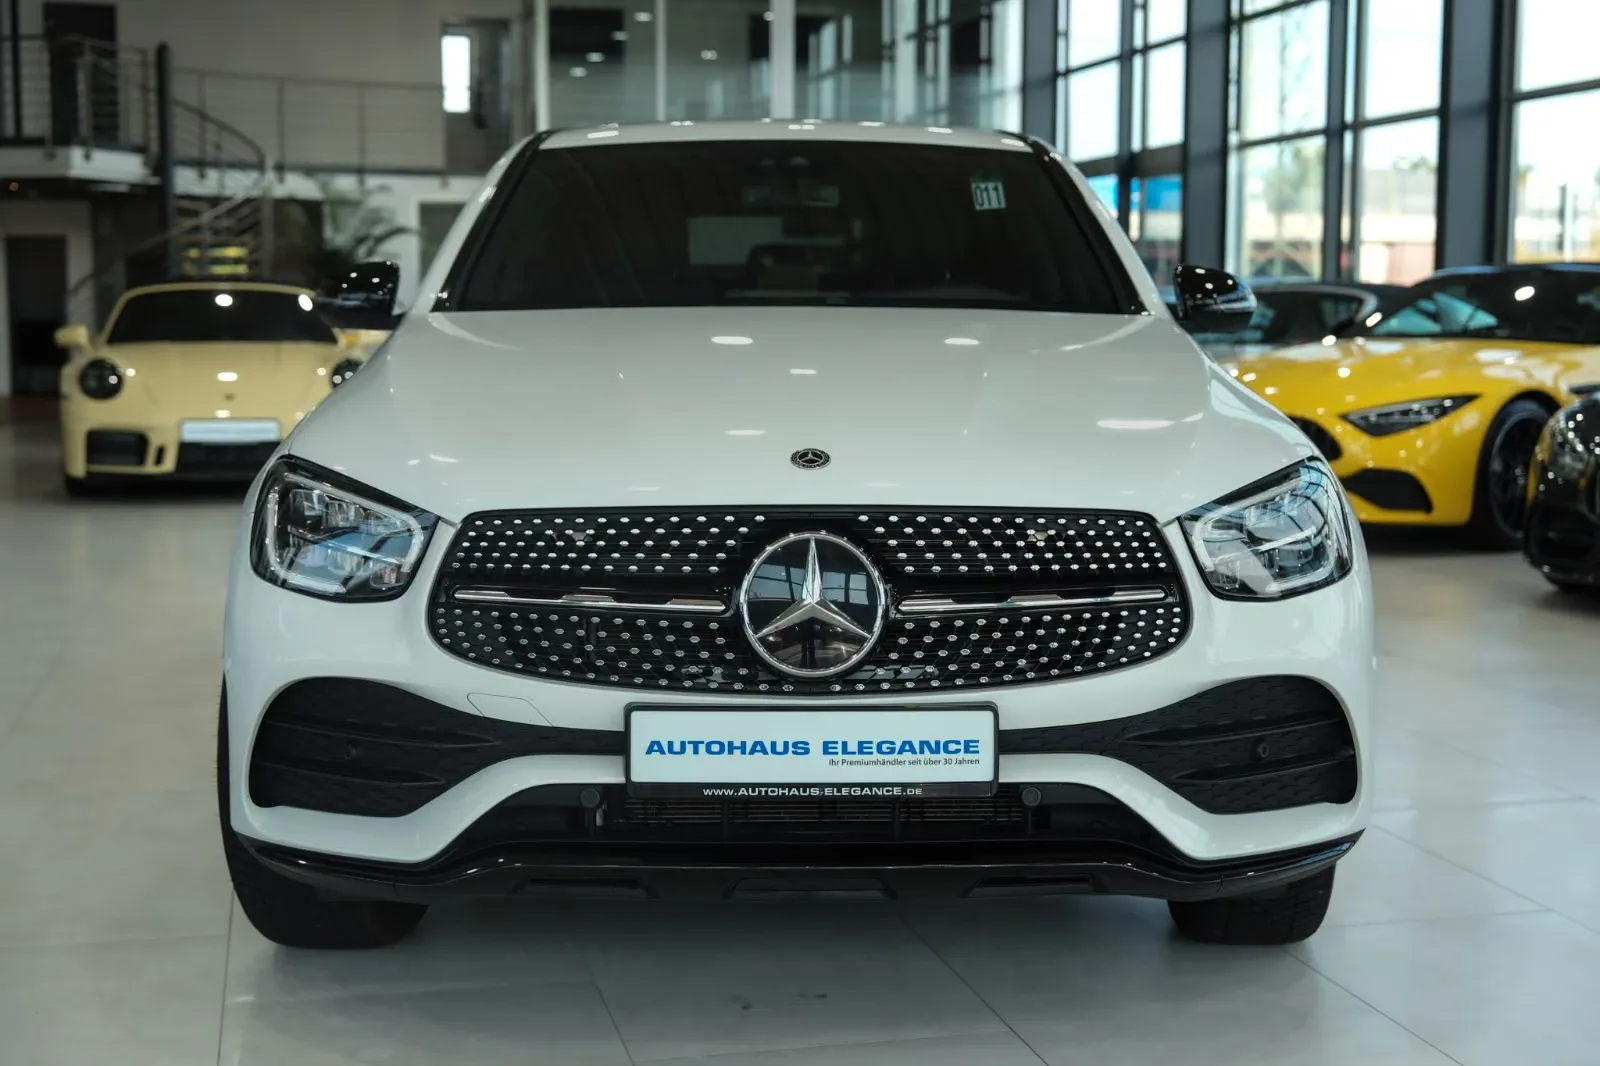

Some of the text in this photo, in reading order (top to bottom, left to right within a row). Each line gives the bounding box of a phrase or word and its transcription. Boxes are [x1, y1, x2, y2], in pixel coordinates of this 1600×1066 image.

[975, 185, 1001, 207] 011
[645, 739, 980, 756] AUTOHAUS ELEGANCE
[828, 757, 980, 767] Ihr Premiumhändler seit über 30 Jahren
[702, 786, 923, 797] www.AUTOHAUS-ELEGANCE.DE
